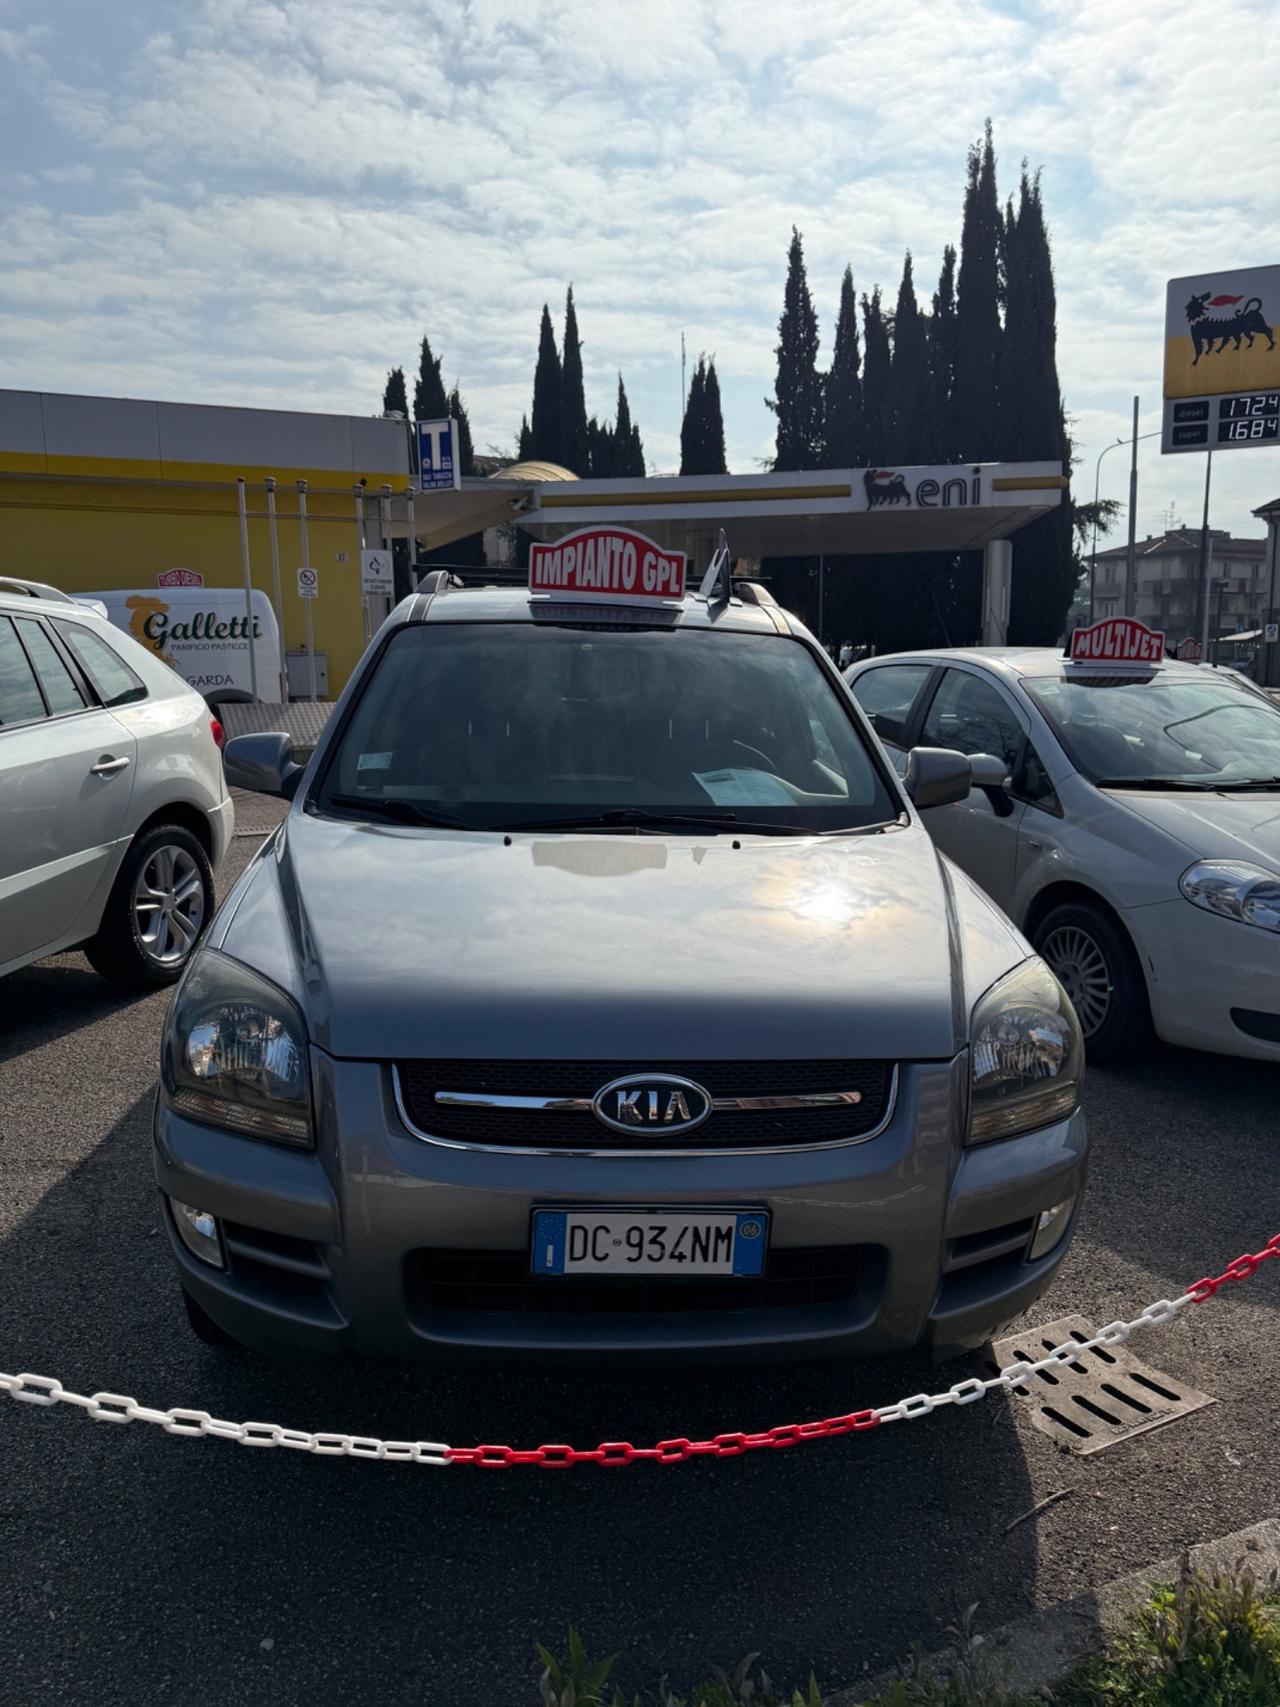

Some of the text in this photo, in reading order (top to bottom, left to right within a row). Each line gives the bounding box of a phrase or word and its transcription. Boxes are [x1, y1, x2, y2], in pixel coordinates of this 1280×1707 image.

[1179, 408, 1204, 417] diesel
[421, 422, 449, 470] T
[916, 467, 981, 507] eni
[535, 536, 680, 592] IMPIANTO GPL
[143, 612, 262, 650] Galletti
[171, 642, 210, 651] PANIFICIO
[1075, 623, 1161, 660] MULTIJET
[186, 674, 234, 686] GARDA
[616, 1090, 692, 1121] KIA
